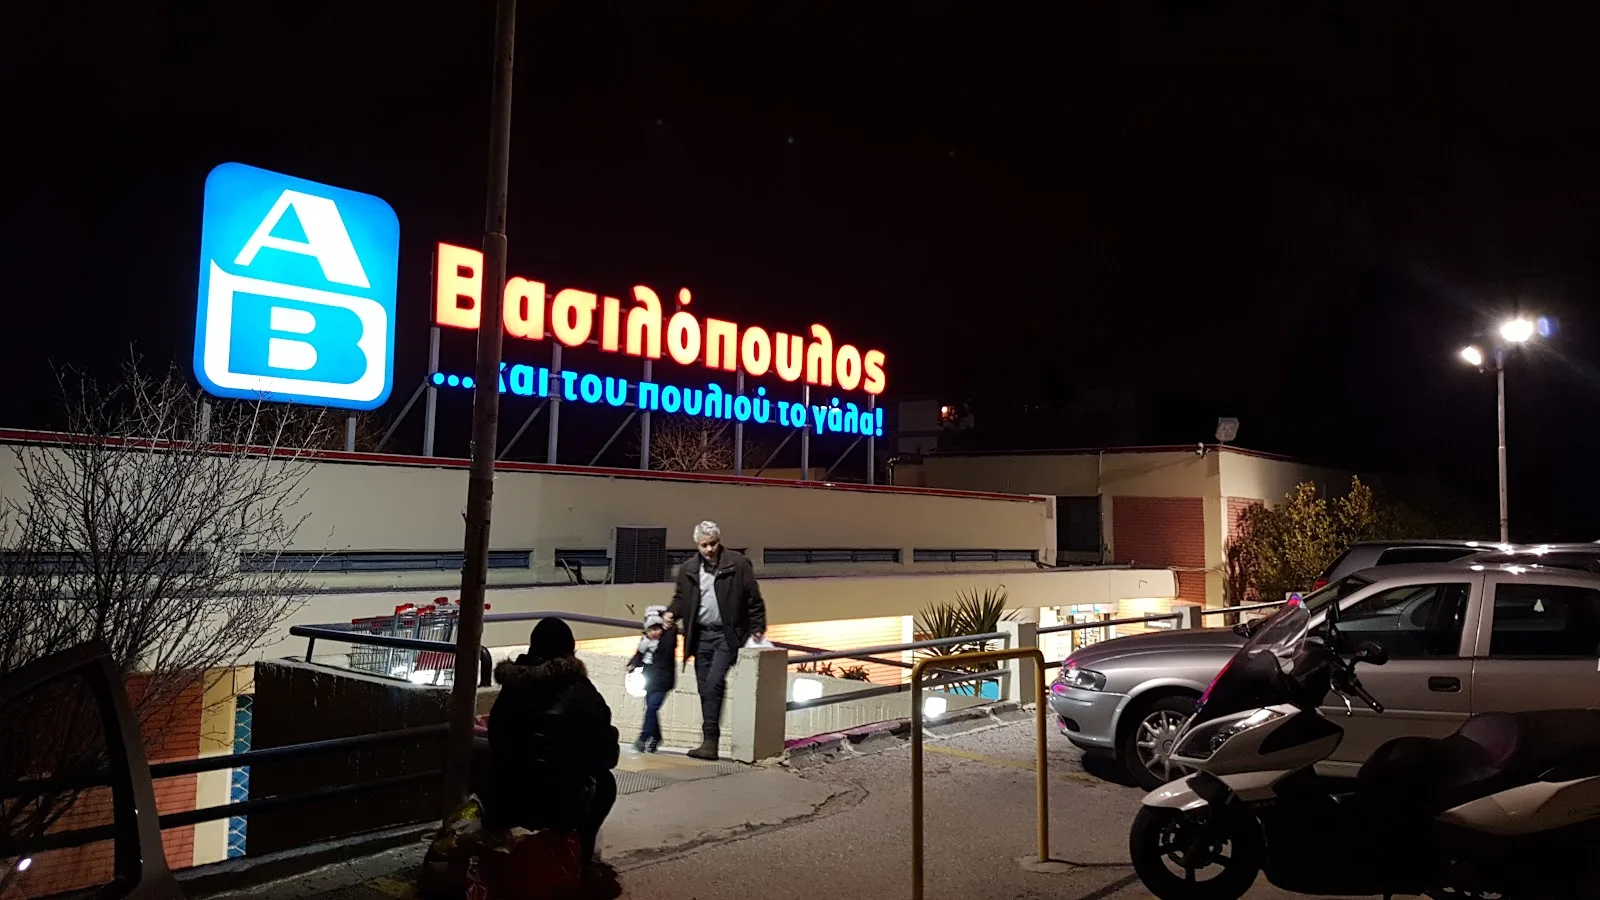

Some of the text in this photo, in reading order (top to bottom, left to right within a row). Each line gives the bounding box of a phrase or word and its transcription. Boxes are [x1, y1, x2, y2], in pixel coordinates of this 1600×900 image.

[435, 242, 887, 395] Βασιλόπουλος
[561, 370, 628, 407] του
[638, 381, 771, 424] πουλιού
[777, 400, 807, 428] το
[811, 396, 884, 438] γάλα!
